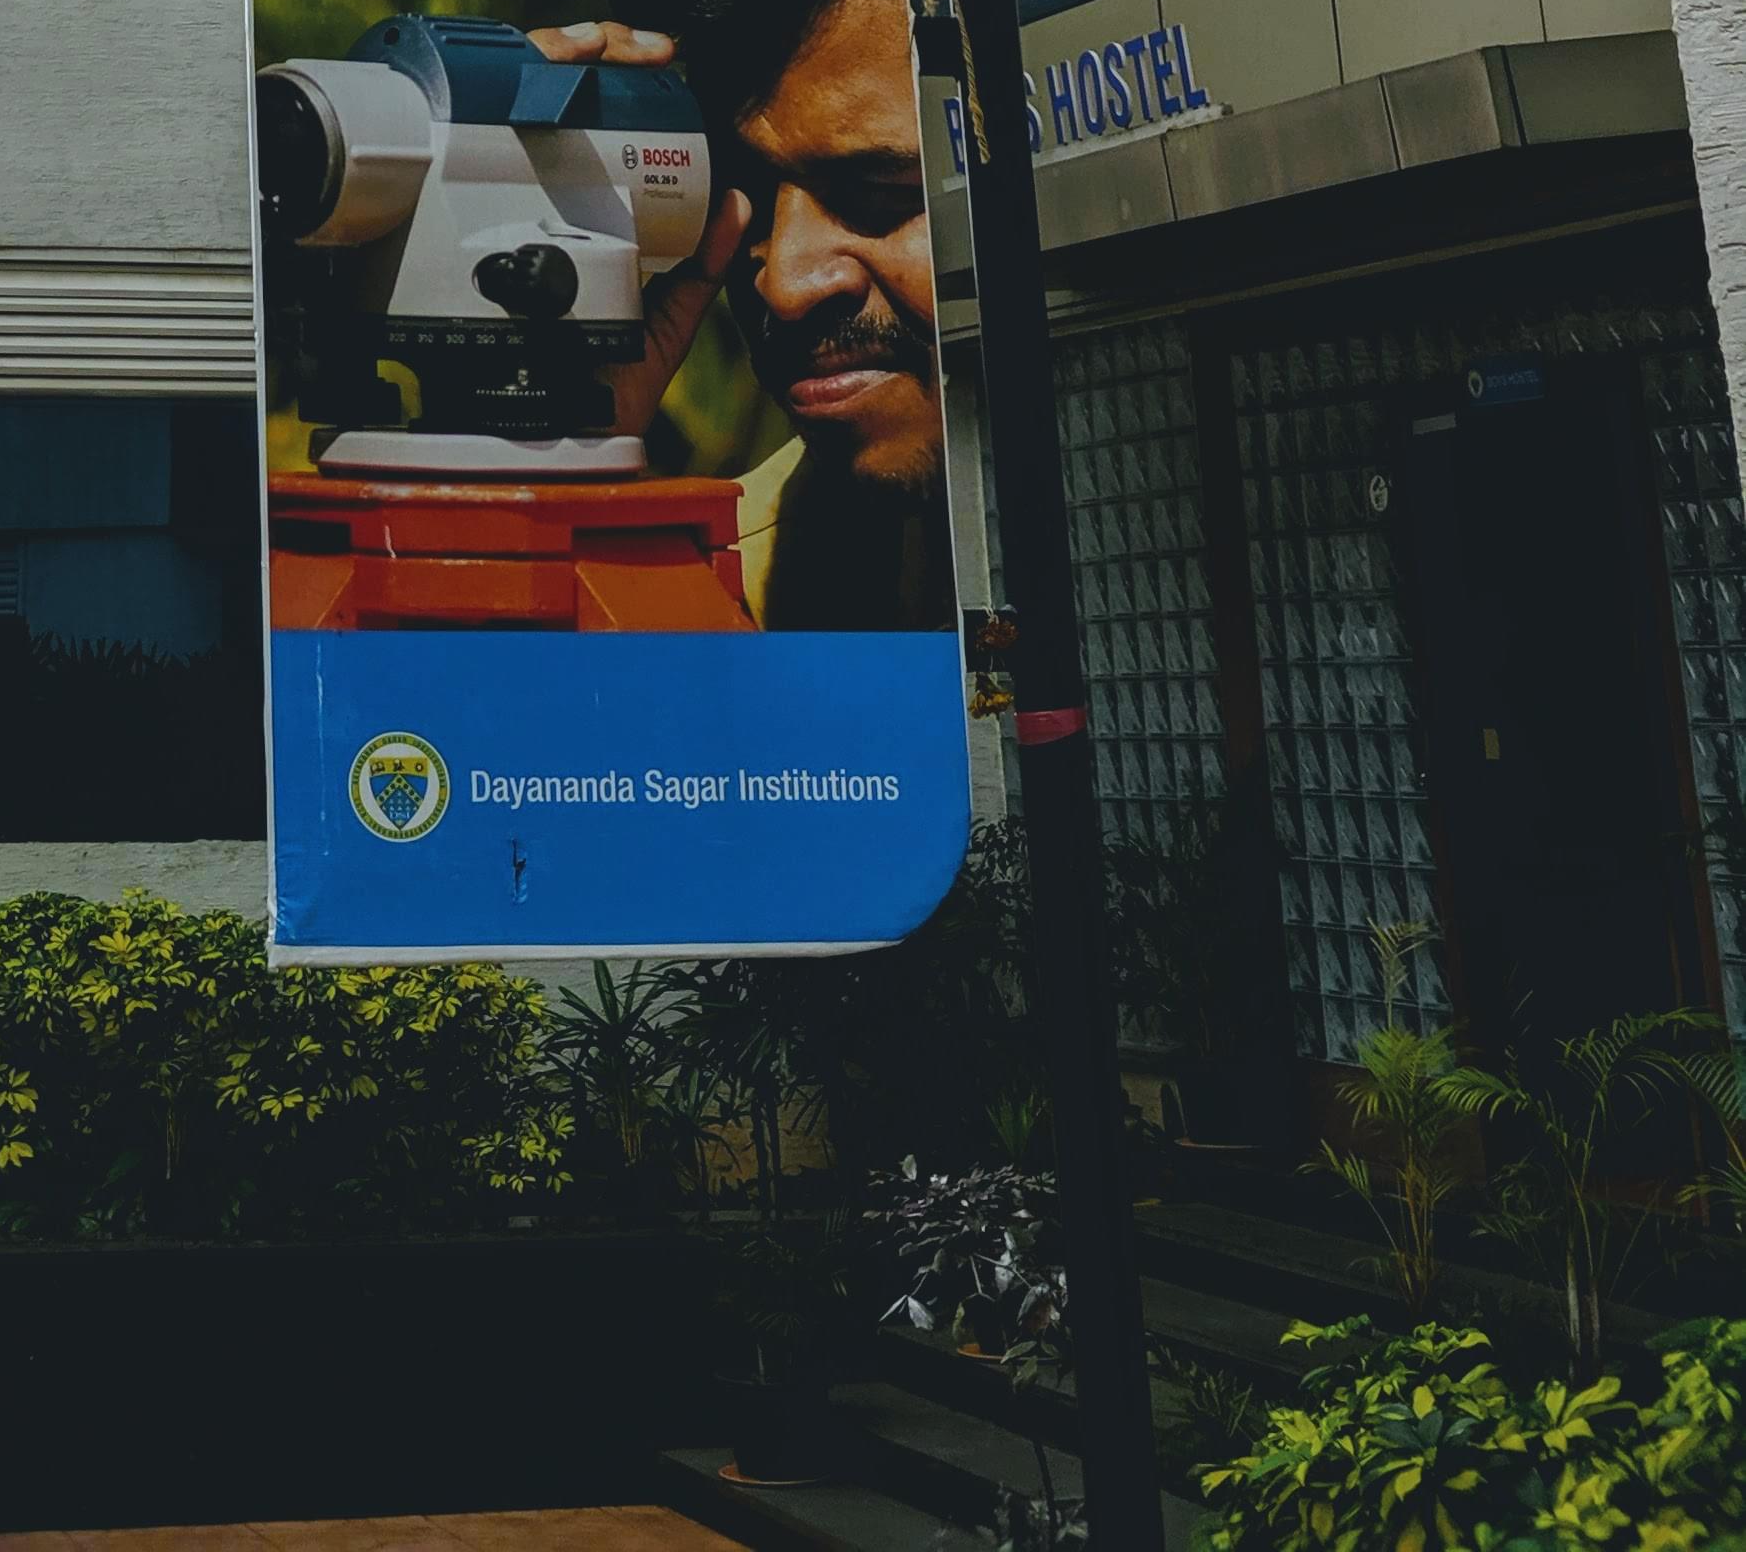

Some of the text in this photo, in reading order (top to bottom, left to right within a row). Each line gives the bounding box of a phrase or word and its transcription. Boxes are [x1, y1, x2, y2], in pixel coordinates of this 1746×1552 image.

[1046, 23, 1210, 145] HOSTEL
[642, 148, 691, 167] BOSCH
[470, 768, 900, 810] Dayananda Sagar Institutions
